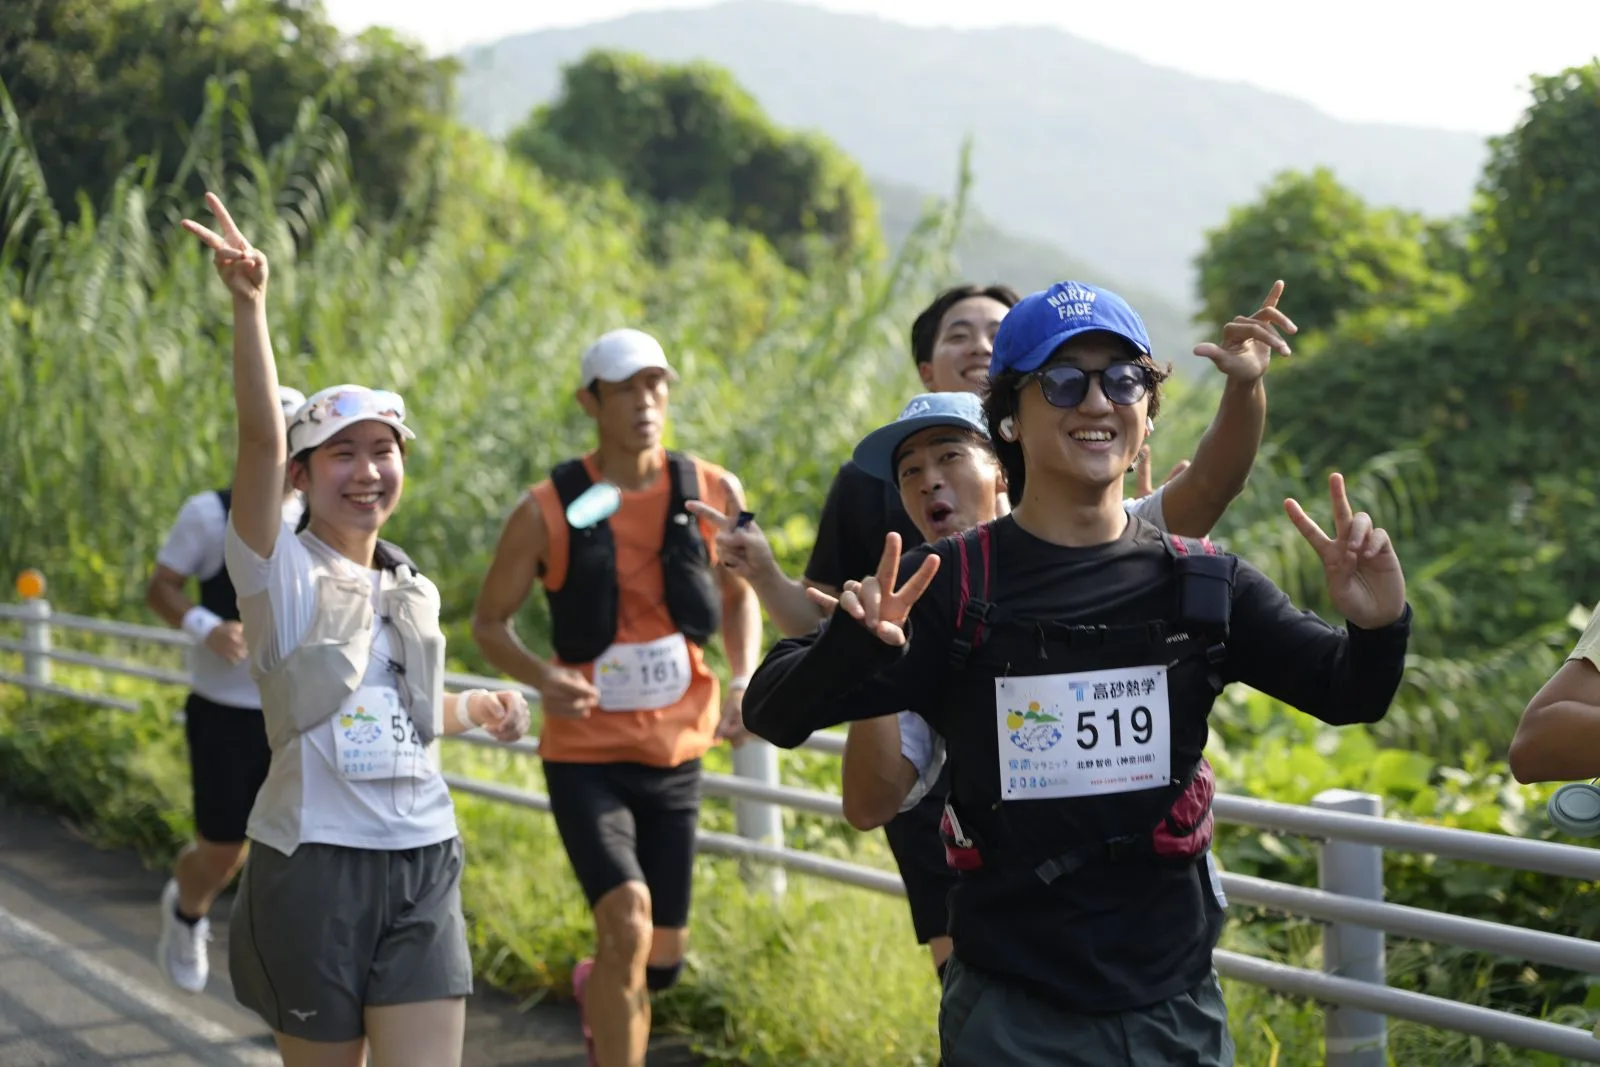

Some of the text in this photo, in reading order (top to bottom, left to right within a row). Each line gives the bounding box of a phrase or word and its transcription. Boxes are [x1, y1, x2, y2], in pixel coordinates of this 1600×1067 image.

[1047, 288, 1096, 308] NORTH
[1058, 303, 1093, 320] FACE
[641, 660, 679, 685] 161
[1093, 678, 1156, 700] 高砂熱学
[1076, 705, 1153, 749] 519
